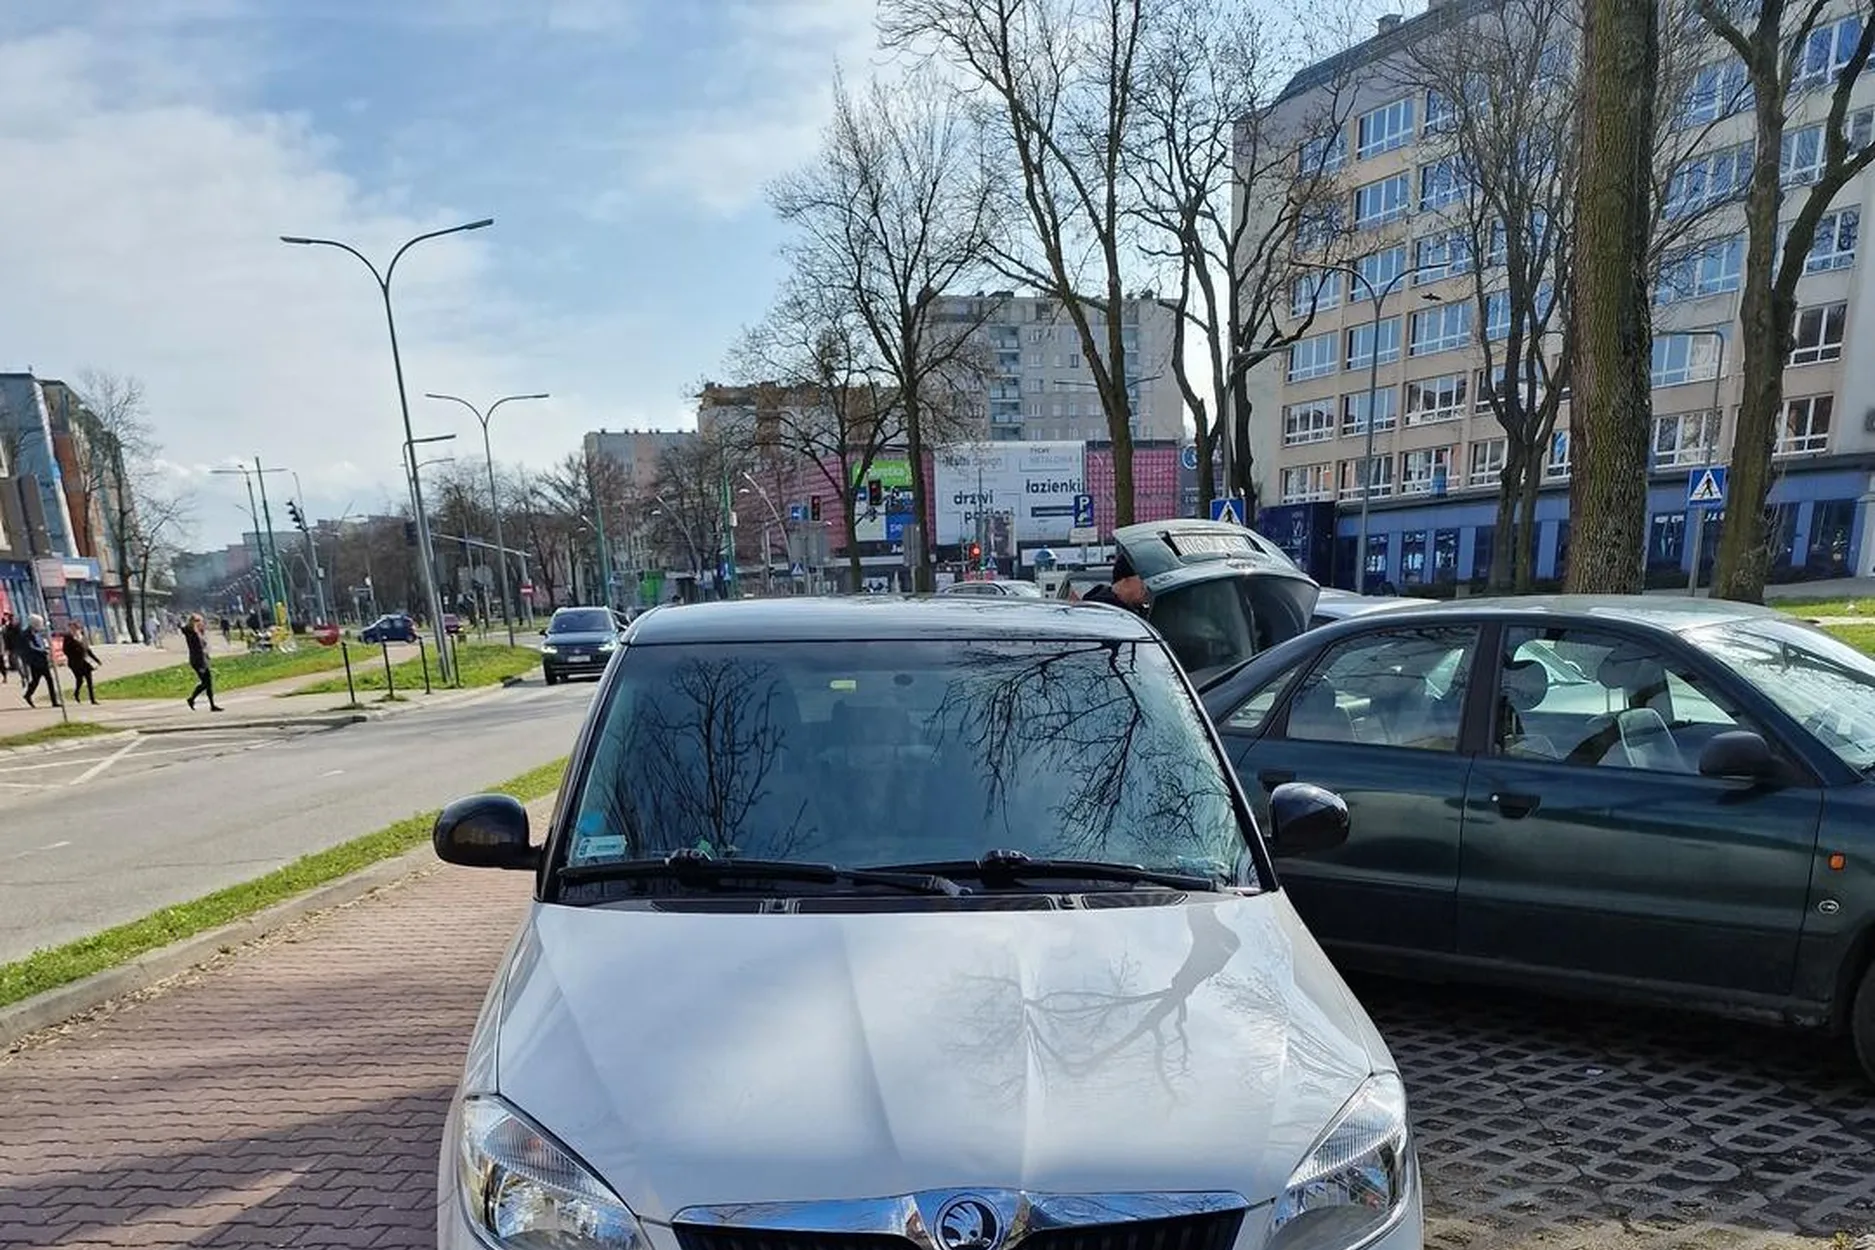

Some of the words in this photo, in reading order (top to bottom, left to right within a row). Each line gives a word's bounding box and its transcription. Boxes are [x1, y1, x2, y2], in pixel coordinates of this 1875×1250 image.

[1025, 479, 1082, 493] łazienki
[953, 489, 993, 505] drzwi
[1079, 496, 1090, 511] P
